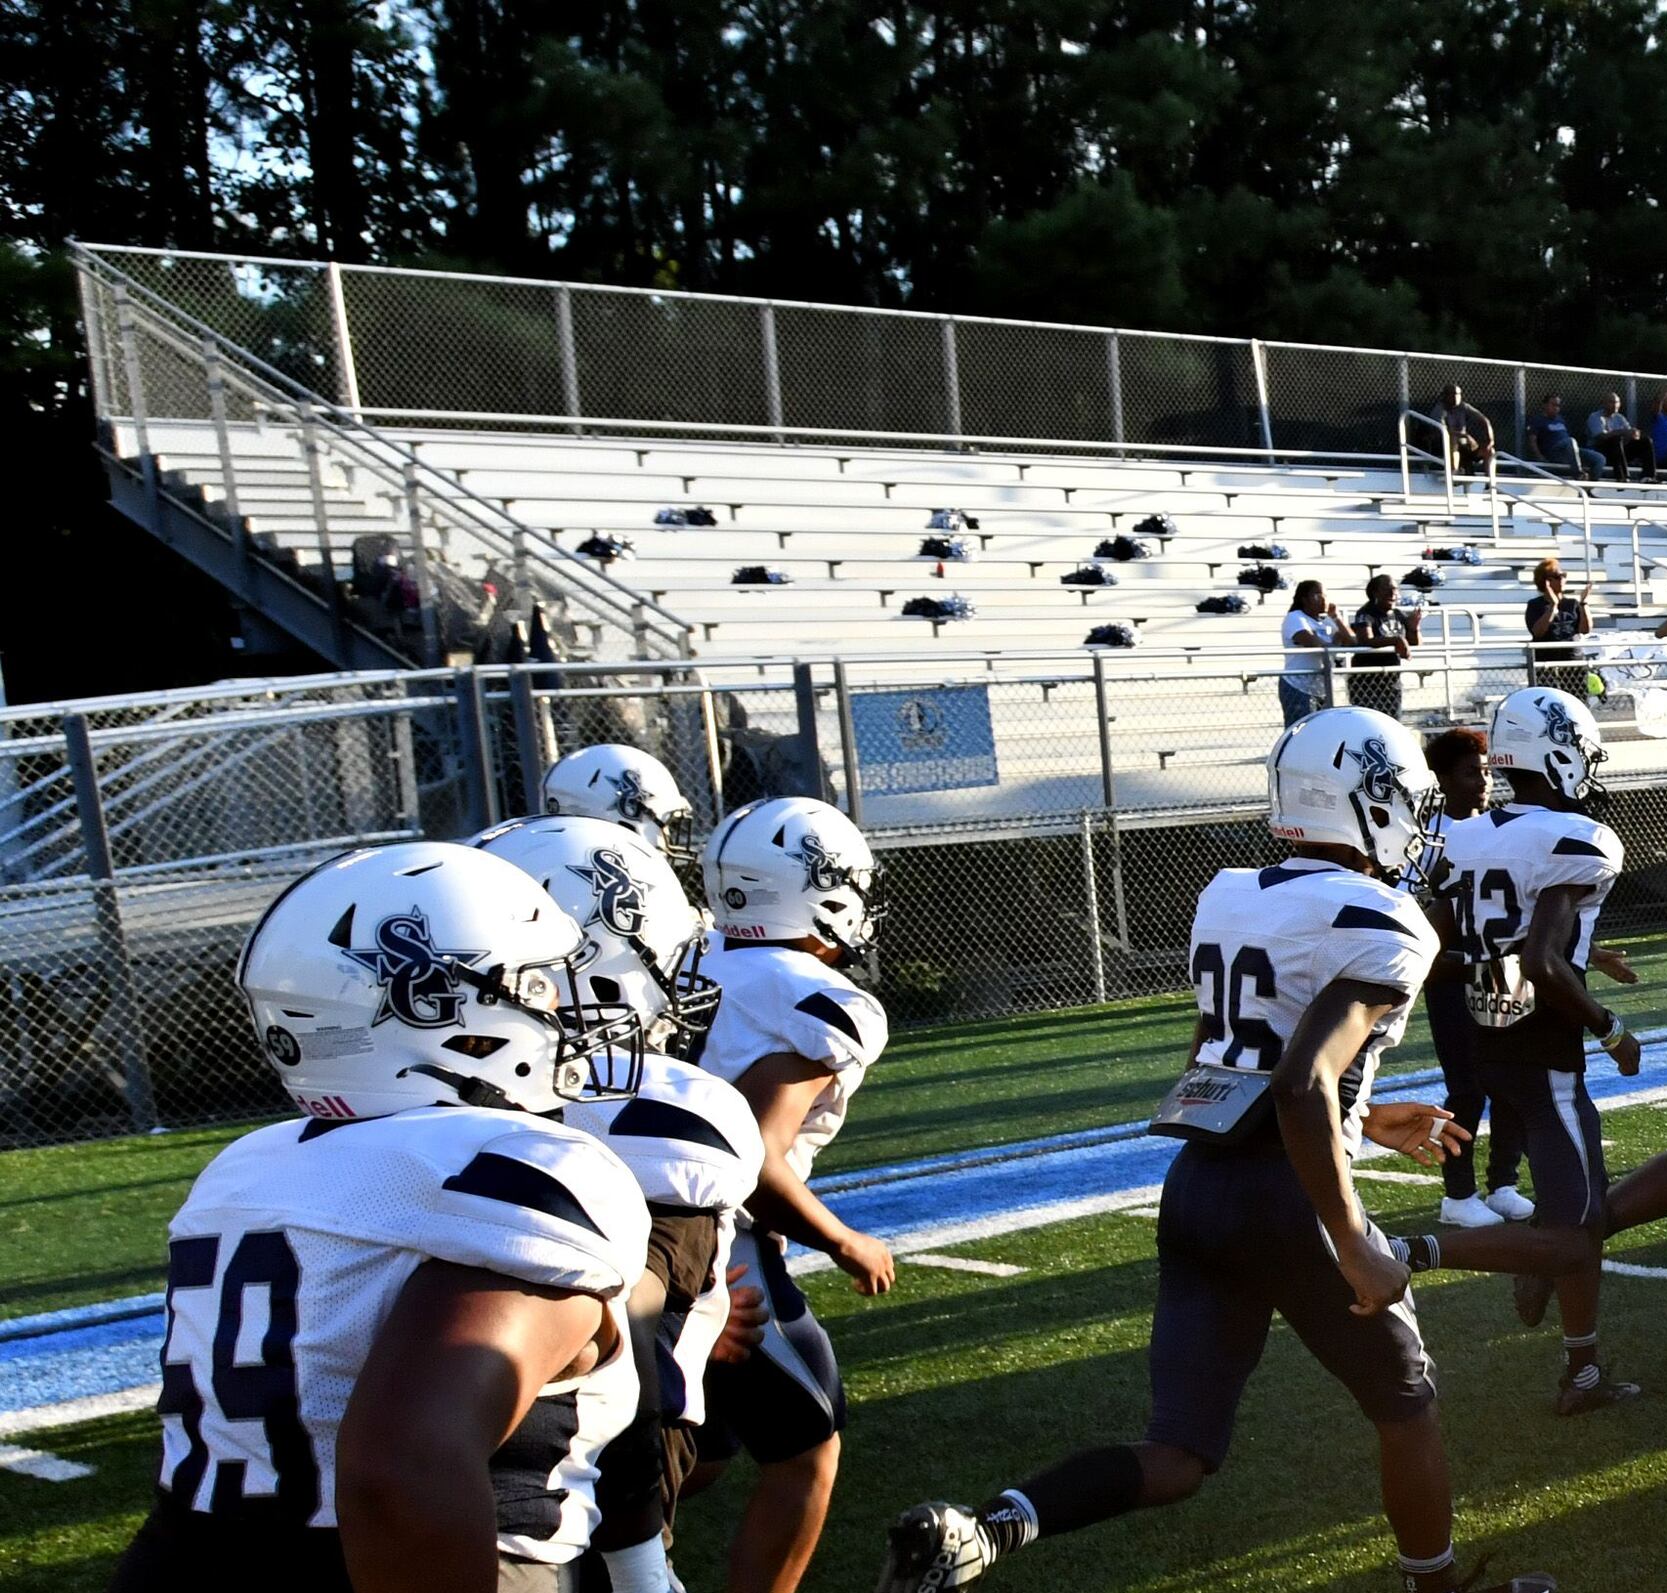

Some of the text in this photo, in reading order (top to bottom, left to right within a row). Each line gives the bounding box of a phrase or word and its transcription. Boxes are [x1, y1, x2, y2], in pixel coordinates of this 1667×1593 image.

[1360, 738, 1397, 803] SG
[591, 849, 649, 938] SG
[800, 835, 838, 892] SG
[729, 892, 745, 907] 60
[375, 913, 468, 1029] SG
[1468, 995, 1523, 1016] adidas
[268, 1029, 295, 1058] 59
[157, 1231, 322, 1526] 59
